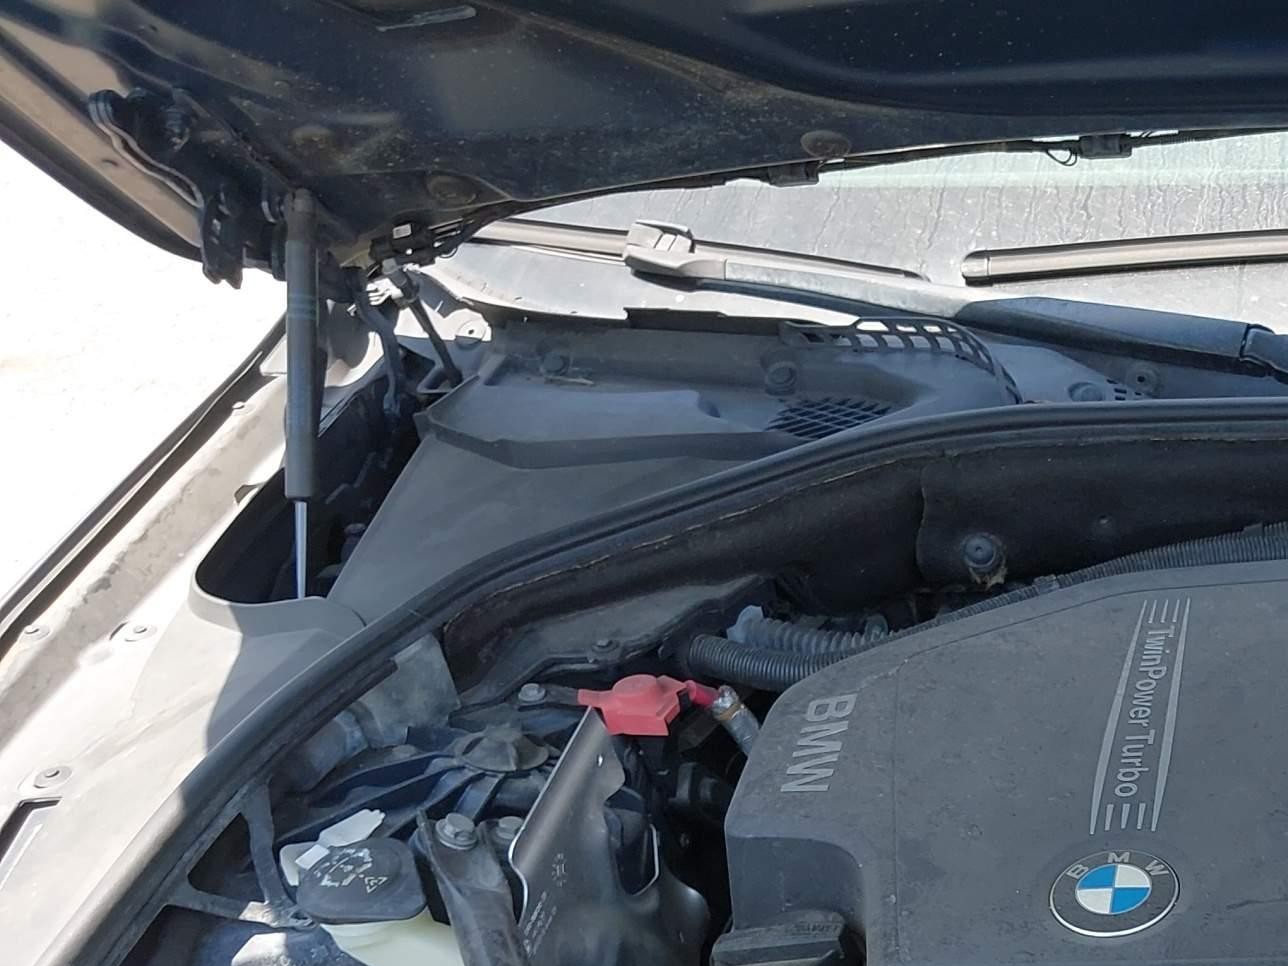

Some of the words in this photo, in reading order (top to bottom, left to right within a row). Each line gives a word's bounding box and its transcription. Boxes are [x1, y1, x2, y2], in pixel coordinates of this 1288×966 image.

[1127, 624, 1176, 728] TwinPower
[781, 693, 858, 793] BMW
[1114, 728, 1157, 798] Turbo
[1065, 852, 1170, 880] BMW
